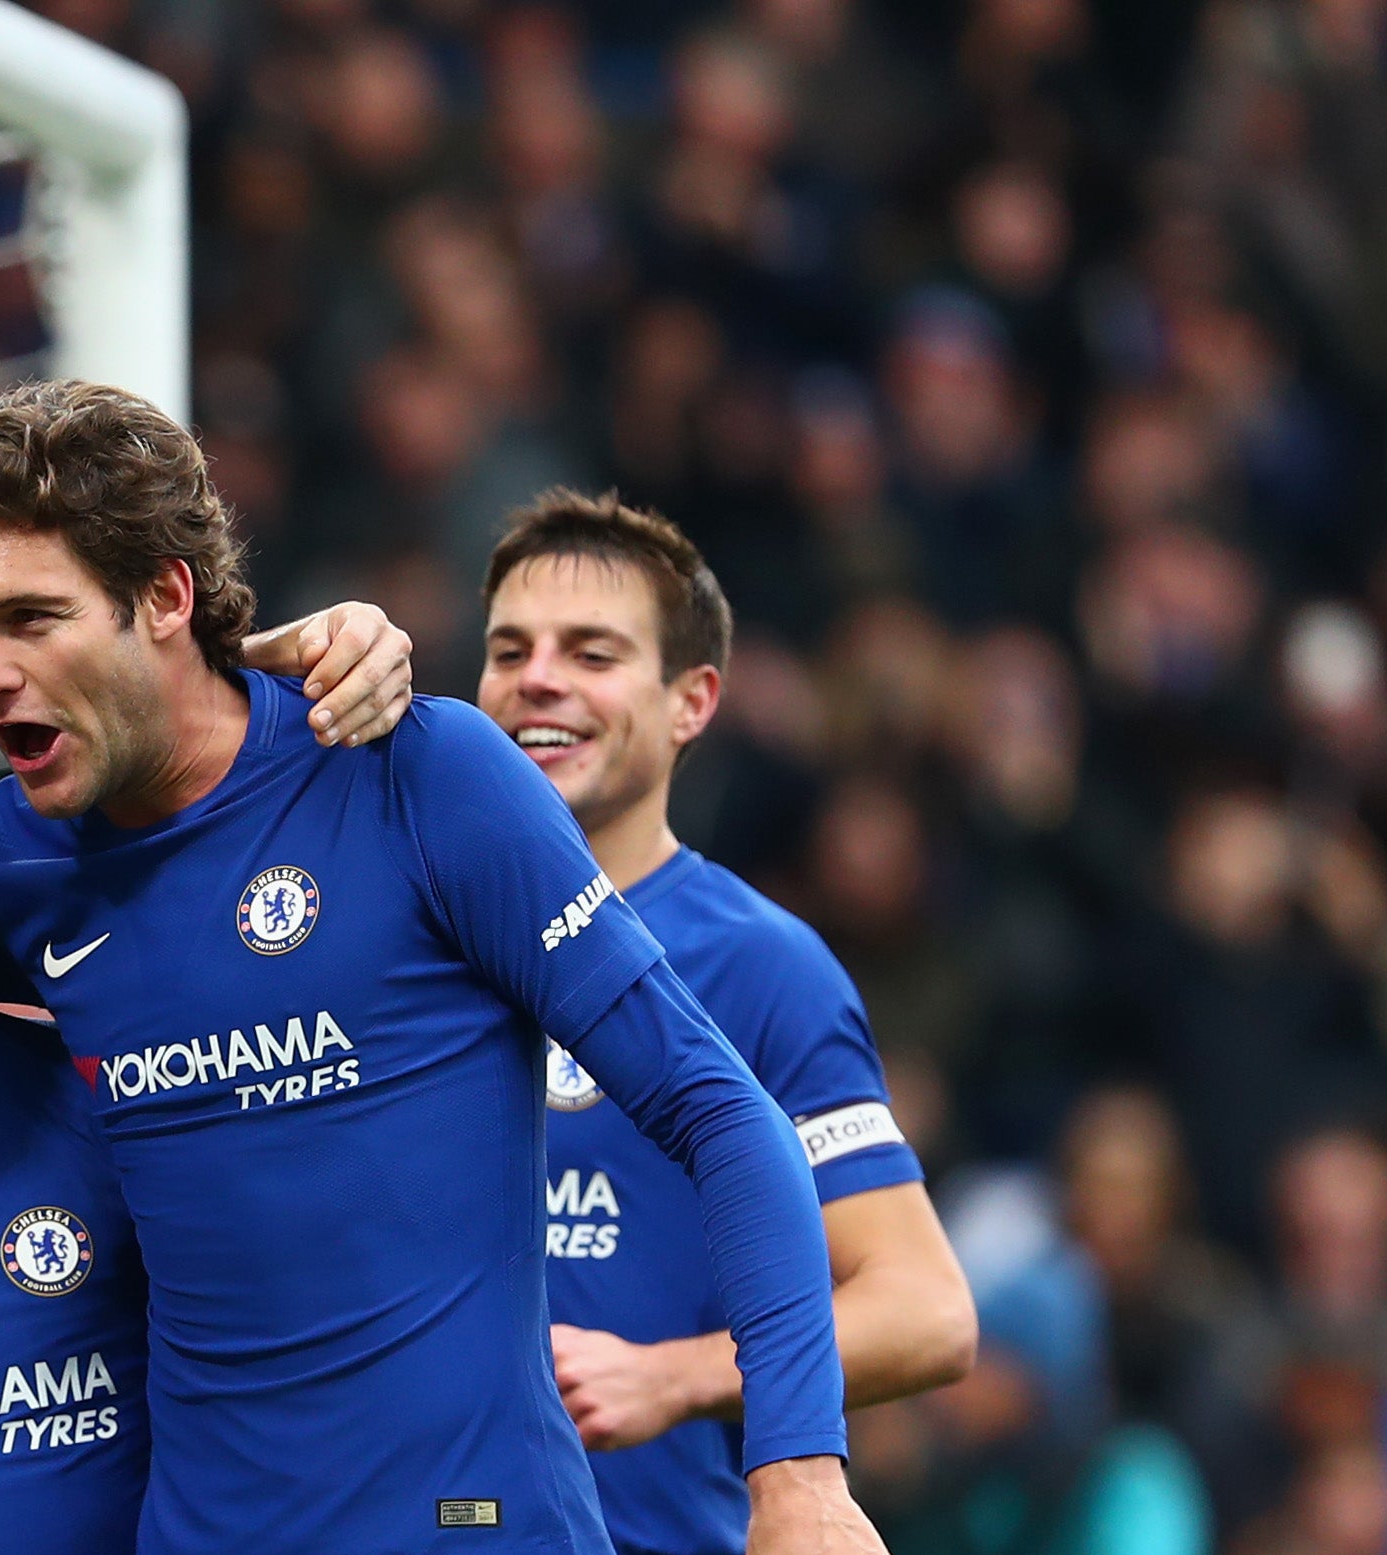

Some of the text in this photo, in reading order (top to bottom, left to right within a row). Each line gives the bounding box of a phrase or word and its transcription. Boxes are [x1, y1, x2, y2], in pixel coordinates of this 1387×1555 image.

[250, 869, 304, 894] CHELSEA
[288, 926, 306, 944] CLUB
[100, 1010, 354, 1102] YOKOHAMA
[234, 1058, 360, 1110] TYRES
[12, 1209, 71, 1234] CHELSEA
[22, 1270, 83, 1292] FOOTBALL CLUB
[1, 1406, 119, 1454] TYRES
